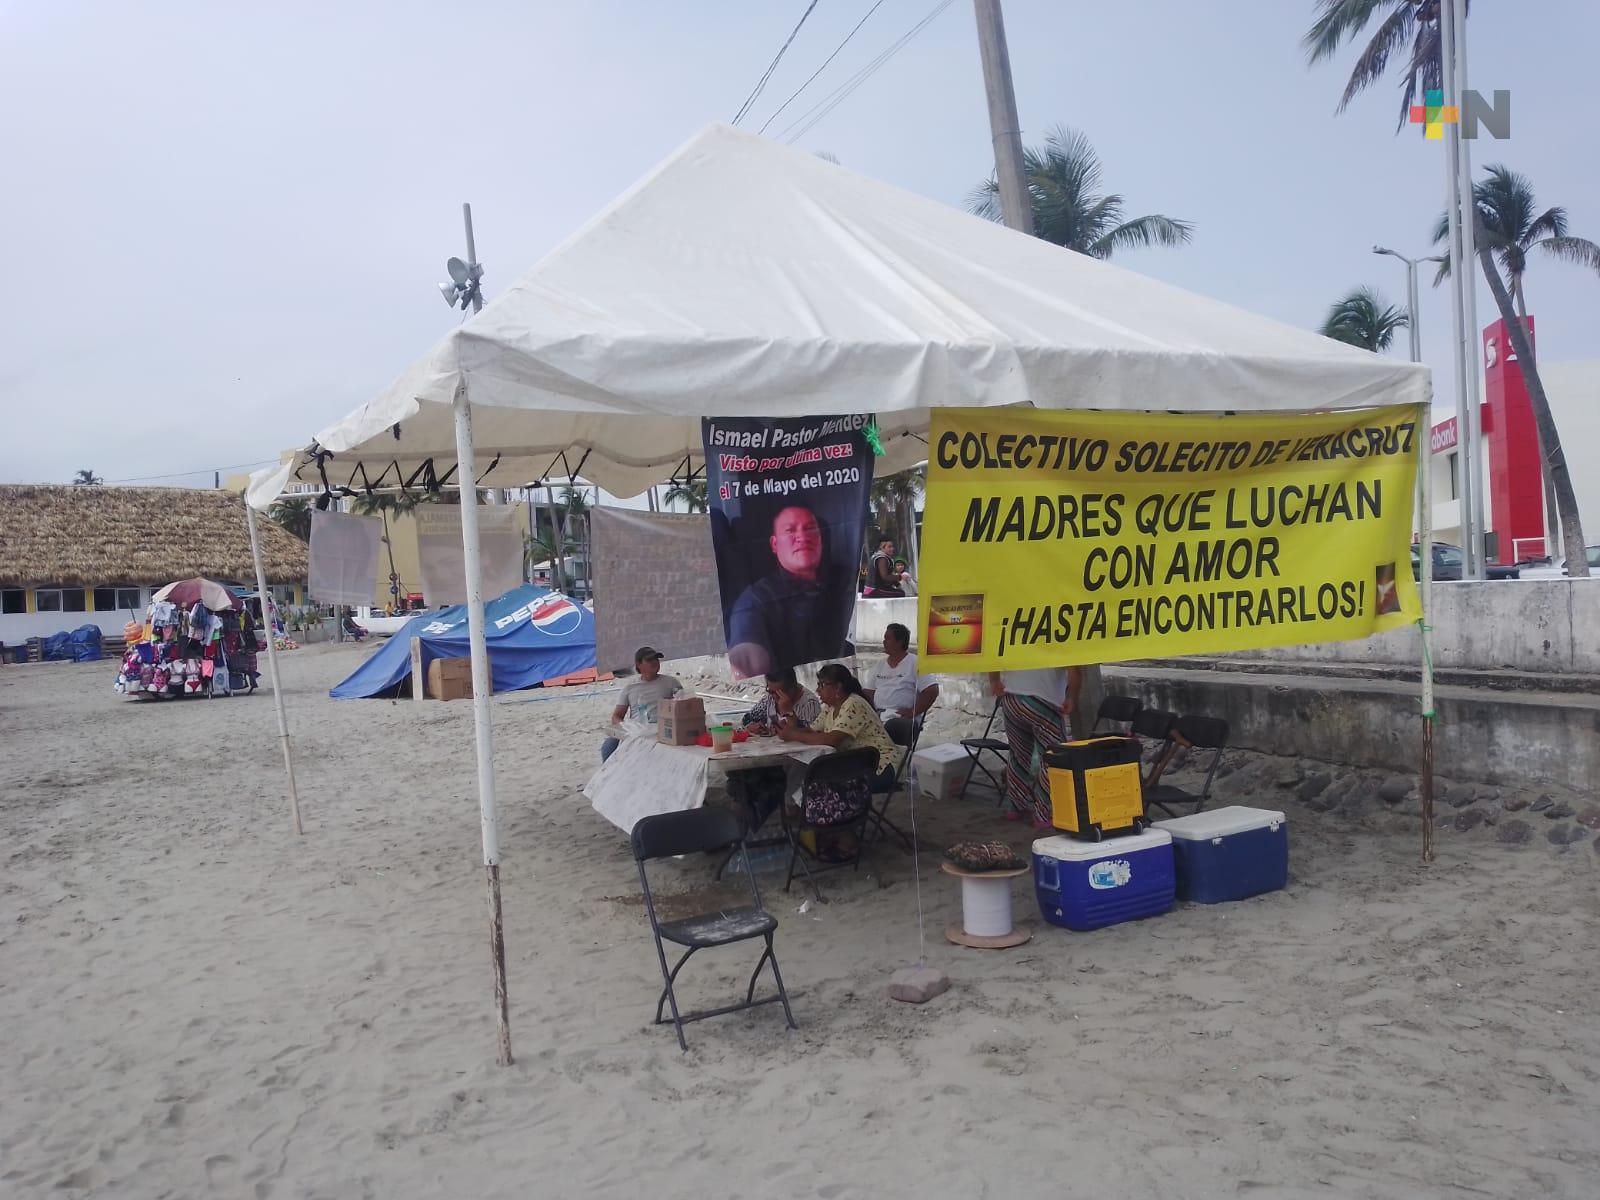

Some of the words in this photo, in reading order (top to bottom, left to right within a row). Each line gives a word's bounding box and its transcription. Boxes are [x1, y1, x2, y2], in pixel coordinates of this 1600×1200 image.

[709, 424, 768, 448] Ismael
[771, 428, 820, 448] Pastor
[937, 431, 1109, 471] COLECTIVO
[1115, 440, 1251, 473] SOLECITO
[1249, 439, 1290, 468] DE
[1285, 422, 1415, 461] VERACRUZ
[1431, 421, 1455, 450] abank
[720, 453, 757, 472] Visto
[758, 457, 785, 473] por
[823, 443, 853, 459] vez:
[719, 482, 731, 500] el
[732, 482, 741, 498] 7
[744, 482, 760, 496] de
[763, 478, 797, 496] Mayo
[801, 472, 822, 489] del
[826, 467, 860, 486] 2020
[960, 493, 1125, 542] MADRES
[1136, 489, 1216, 538] QUE
[1225, 479, 1381, 529] LUCHAN
[1083, 543, 1156, 592] CON
[1164, 536, 1280, 585] AMOR
[998, 601, 1107, 657] ¡HASTA
[1115, 580, 1365, 638] ENCONTRARLOS!
